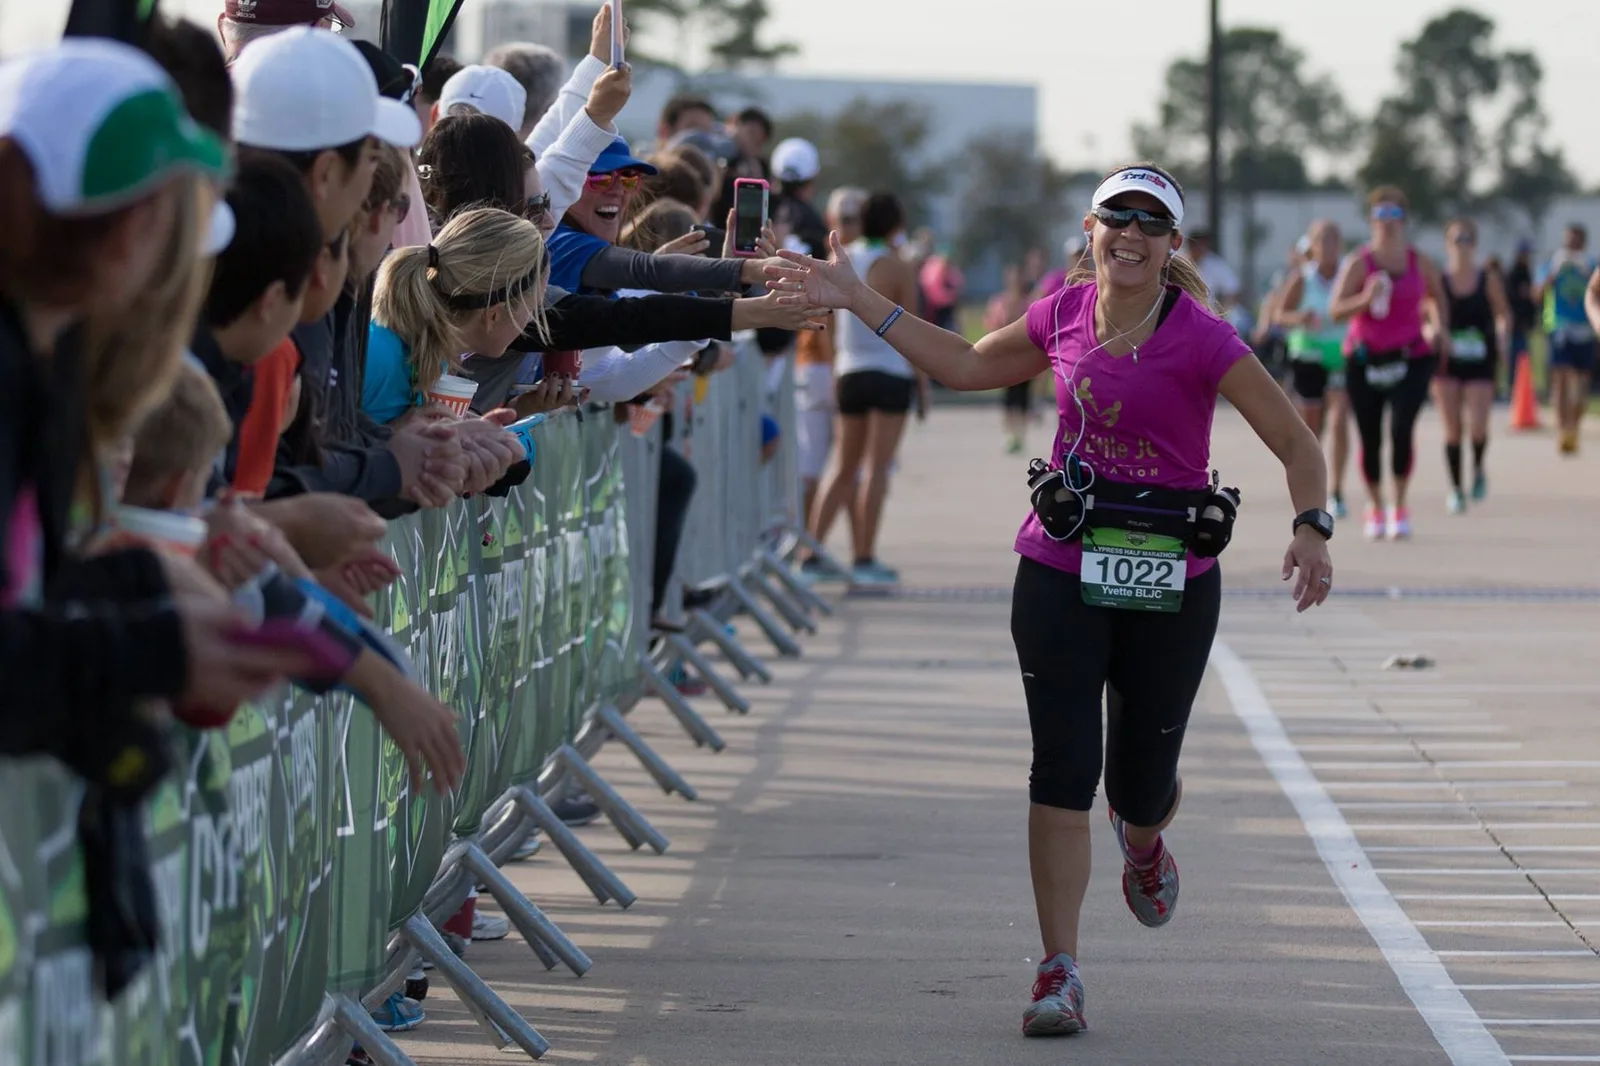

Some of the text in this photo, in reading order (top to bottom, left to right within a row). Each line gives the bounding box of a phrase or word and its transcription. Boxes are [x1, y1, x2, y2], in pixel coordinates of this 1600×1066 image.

[1093, 546, 1178, 559] CYPRESS HALF MARATHON
[1096, 556, 1174, 588] 1022
[1101, 585, 1133, 597] Yvette
[1135, 588, 1163, 599] BLJC
